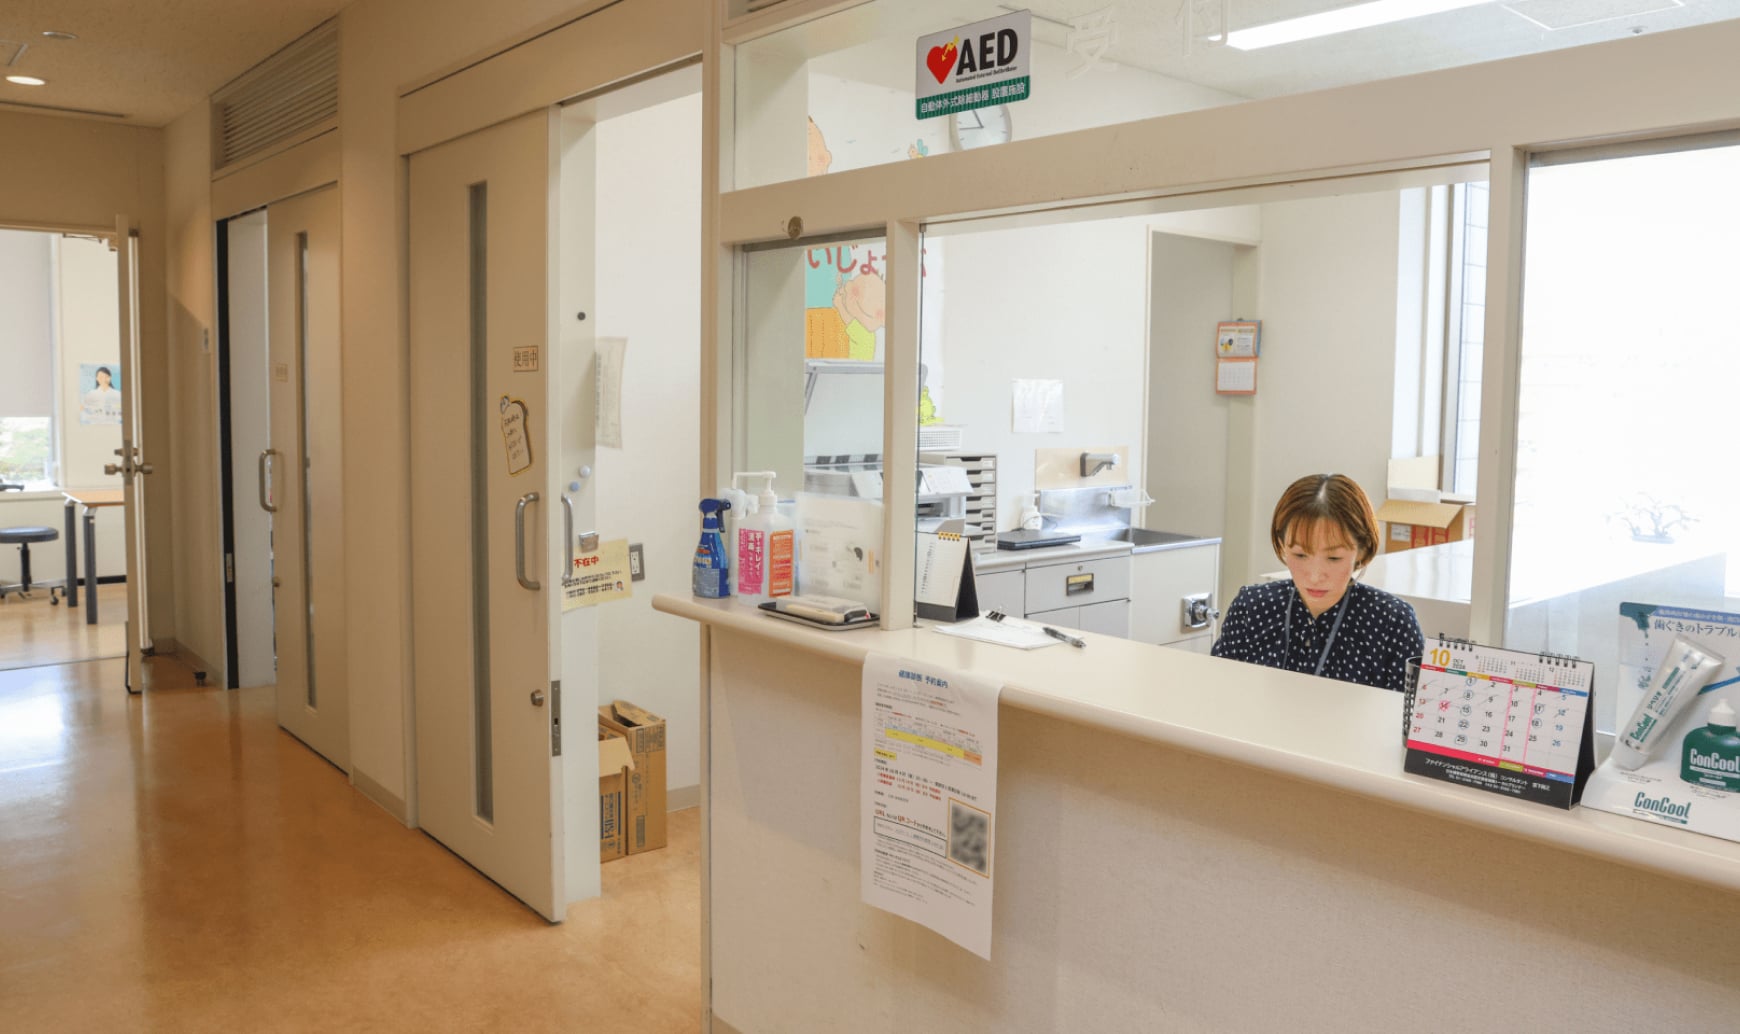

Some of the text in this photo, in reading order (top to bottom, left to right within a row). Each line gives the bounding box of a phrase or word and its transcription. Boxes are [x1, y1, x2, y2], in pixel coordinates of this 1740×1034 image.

[956, 28, 1018, 76] AED
[513, 349, 537, 368] 使用中
[573, 555, 599, 569] 不在中
[1654, 618, 1740, 638] 歯ぐきのトラブル
[1430, 648, 1451, 667] 10
[1629, 713, 1654, 740] ConCool
[1690, 748, 1740, 773] ConCool
[1634, 791, 1692, 818] ConCool
